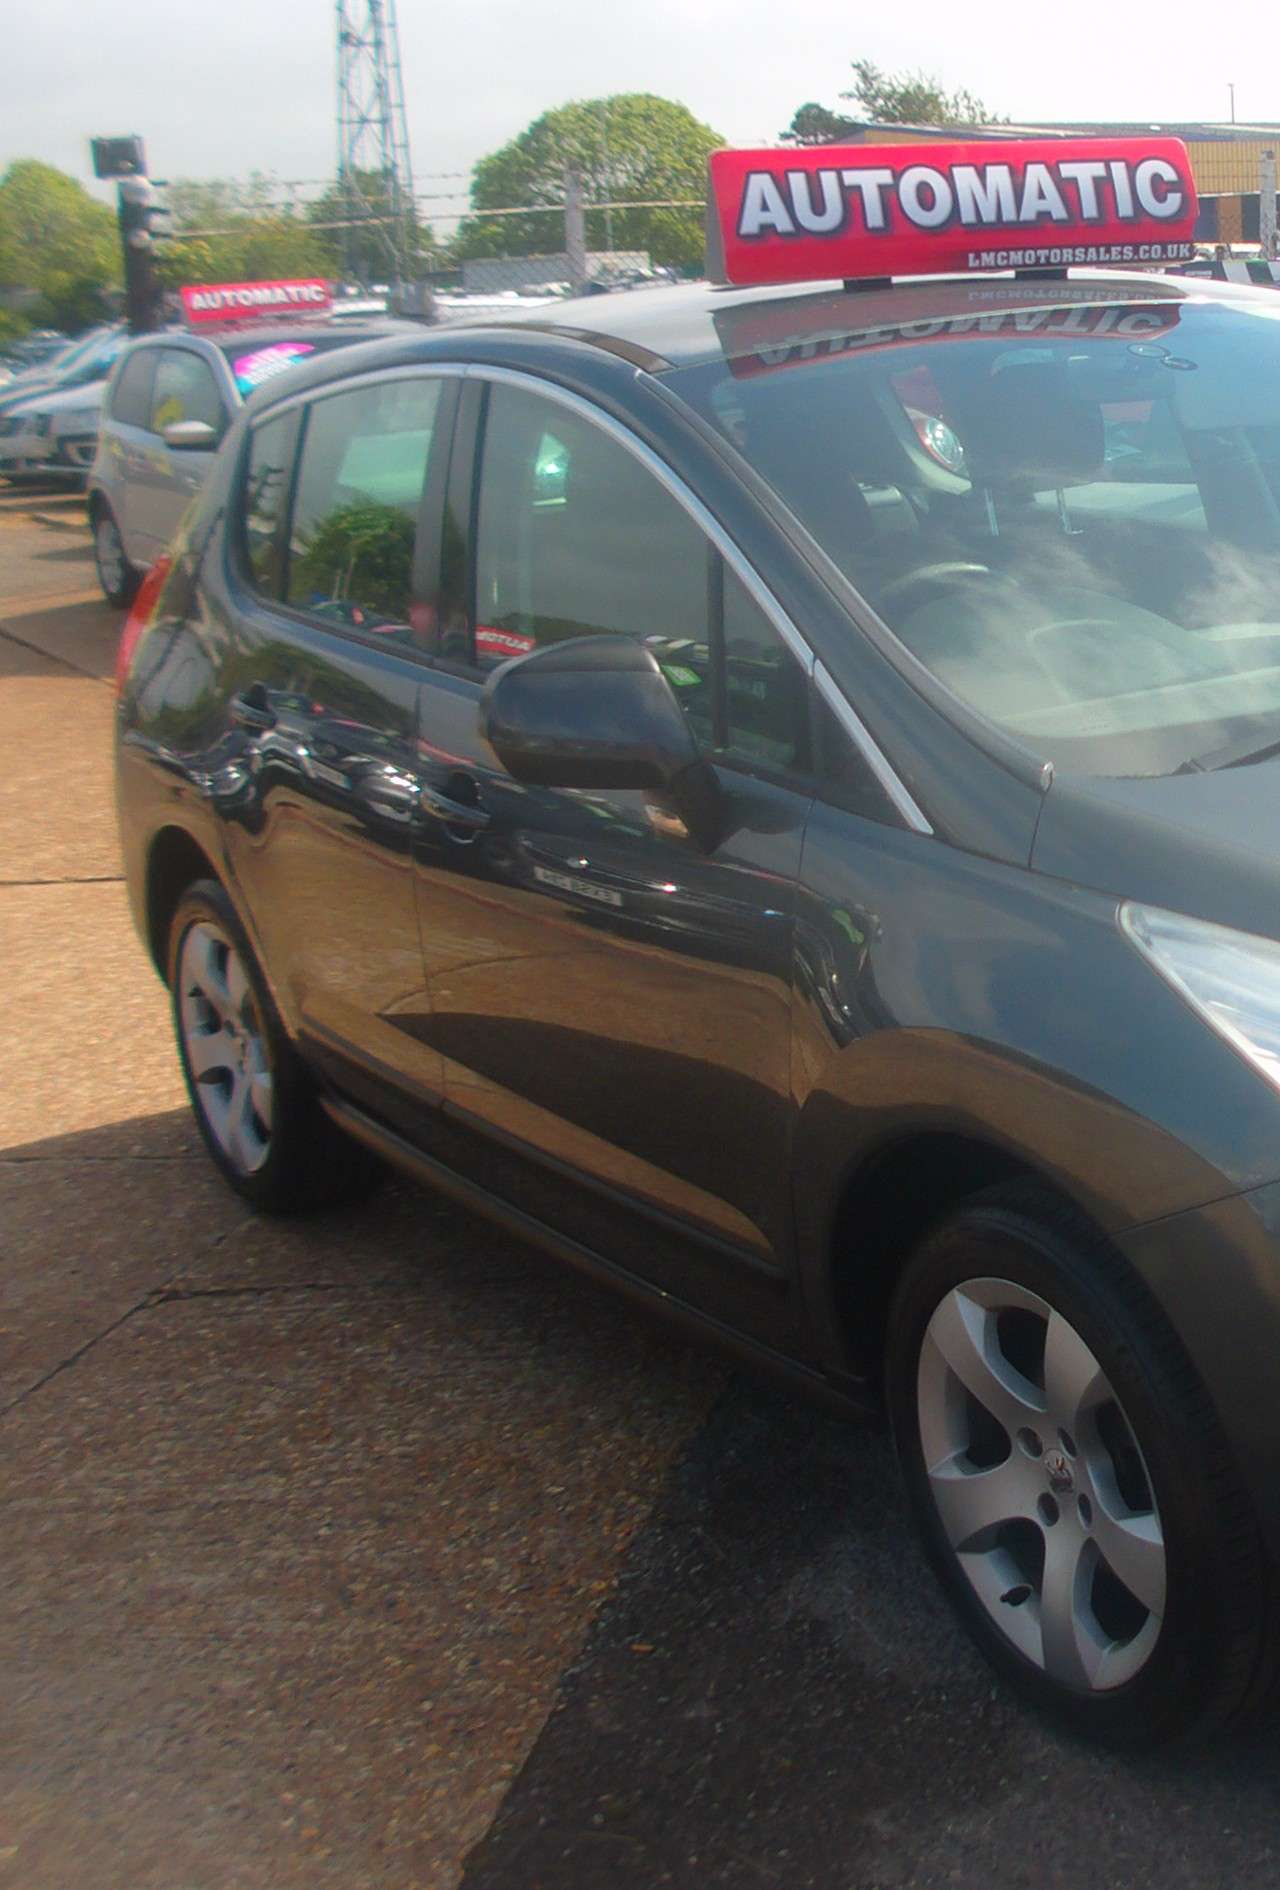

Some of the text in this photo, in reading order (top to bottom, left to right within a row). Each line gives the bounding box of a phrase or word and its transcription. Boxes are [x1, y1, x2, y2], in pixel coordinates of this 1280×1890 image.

[738, 158, 1184, 237] AUTOMATIC
[968, 243, 1191, 268] LMCMOTORSALES.CO.UK
[191, 283, 325, 310] AUTOMATIC
